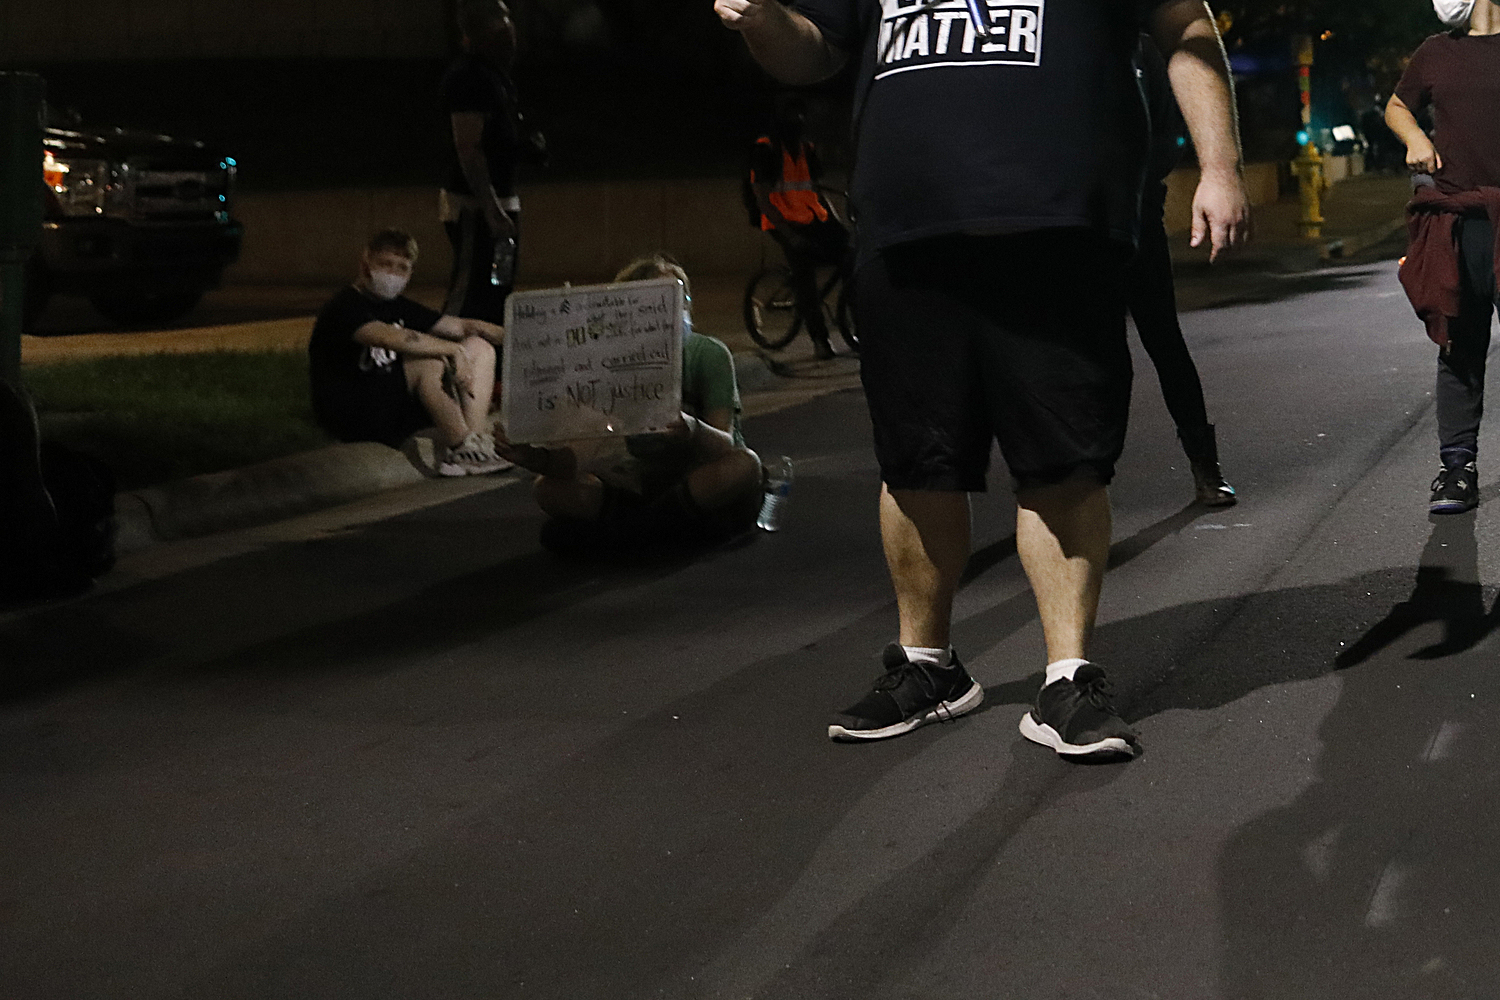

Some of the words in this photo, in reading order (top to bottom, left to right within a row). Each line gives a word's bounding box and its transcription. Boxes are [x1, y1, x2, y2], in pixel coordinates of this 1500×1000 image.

[537, 390, 557, 411] is
[566, 378, 601, 409] NOT
[601, 375, 664, 416] justice
